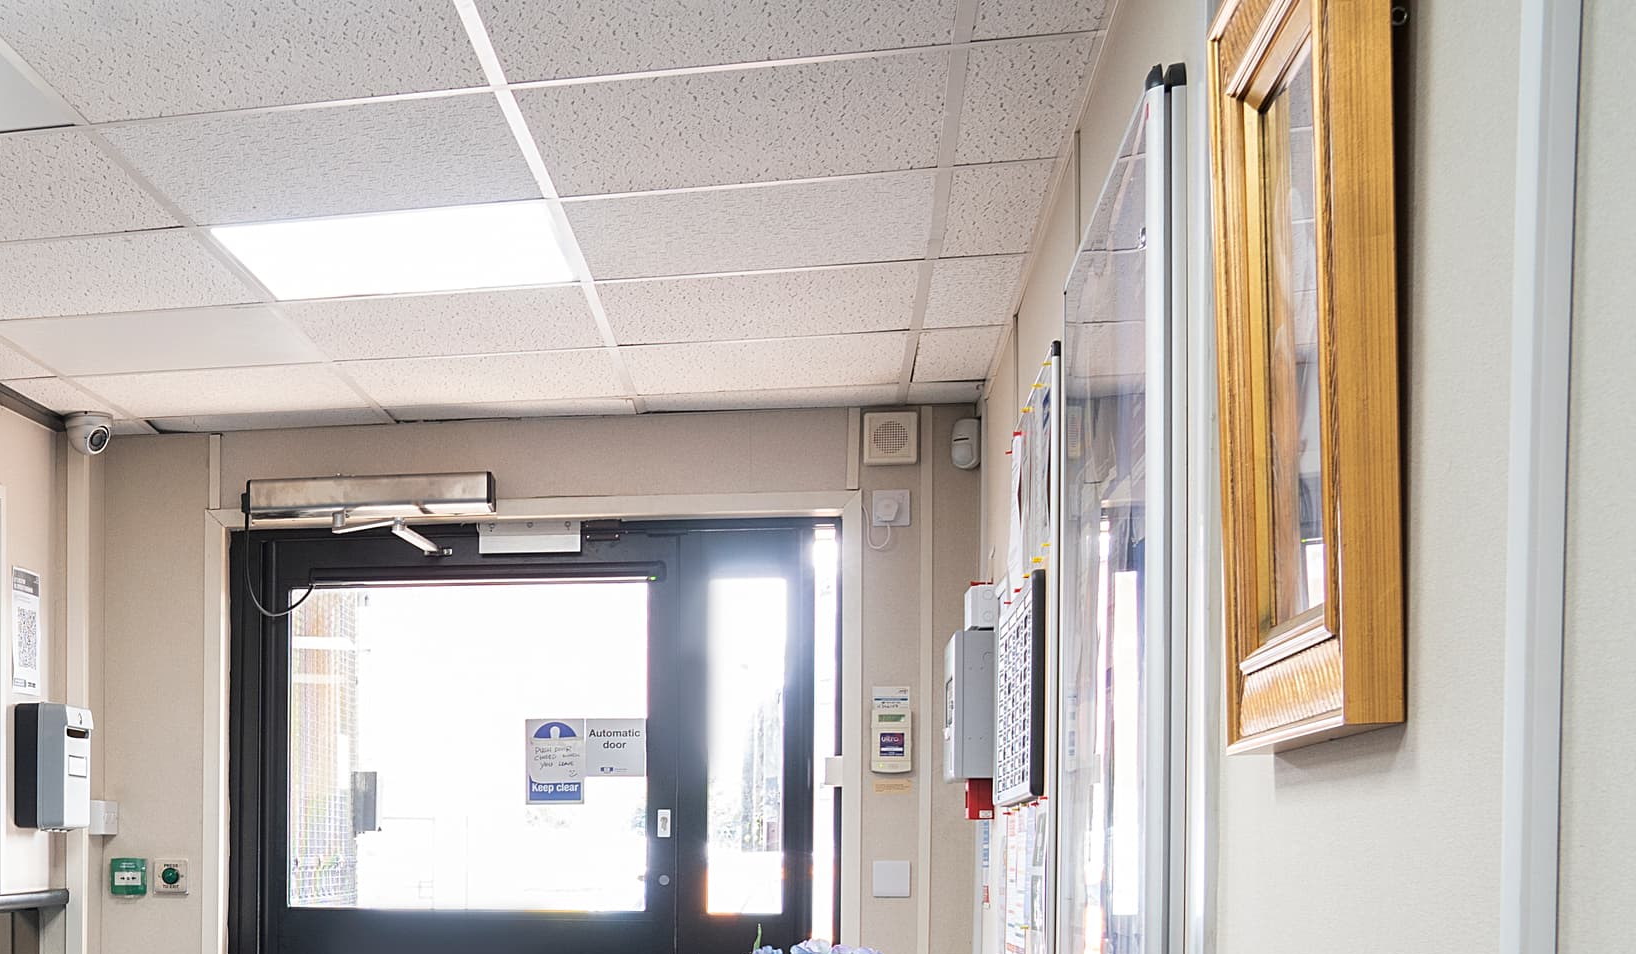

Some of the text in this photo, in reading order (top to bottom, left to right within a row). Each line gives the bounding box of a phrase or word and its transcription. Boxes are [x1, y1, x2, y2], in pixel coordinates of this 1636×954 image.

[588, 729, 641, 738] Automatic
[602, 741, 627, 749] door
[531, 783, 579, 794] Keep clear
